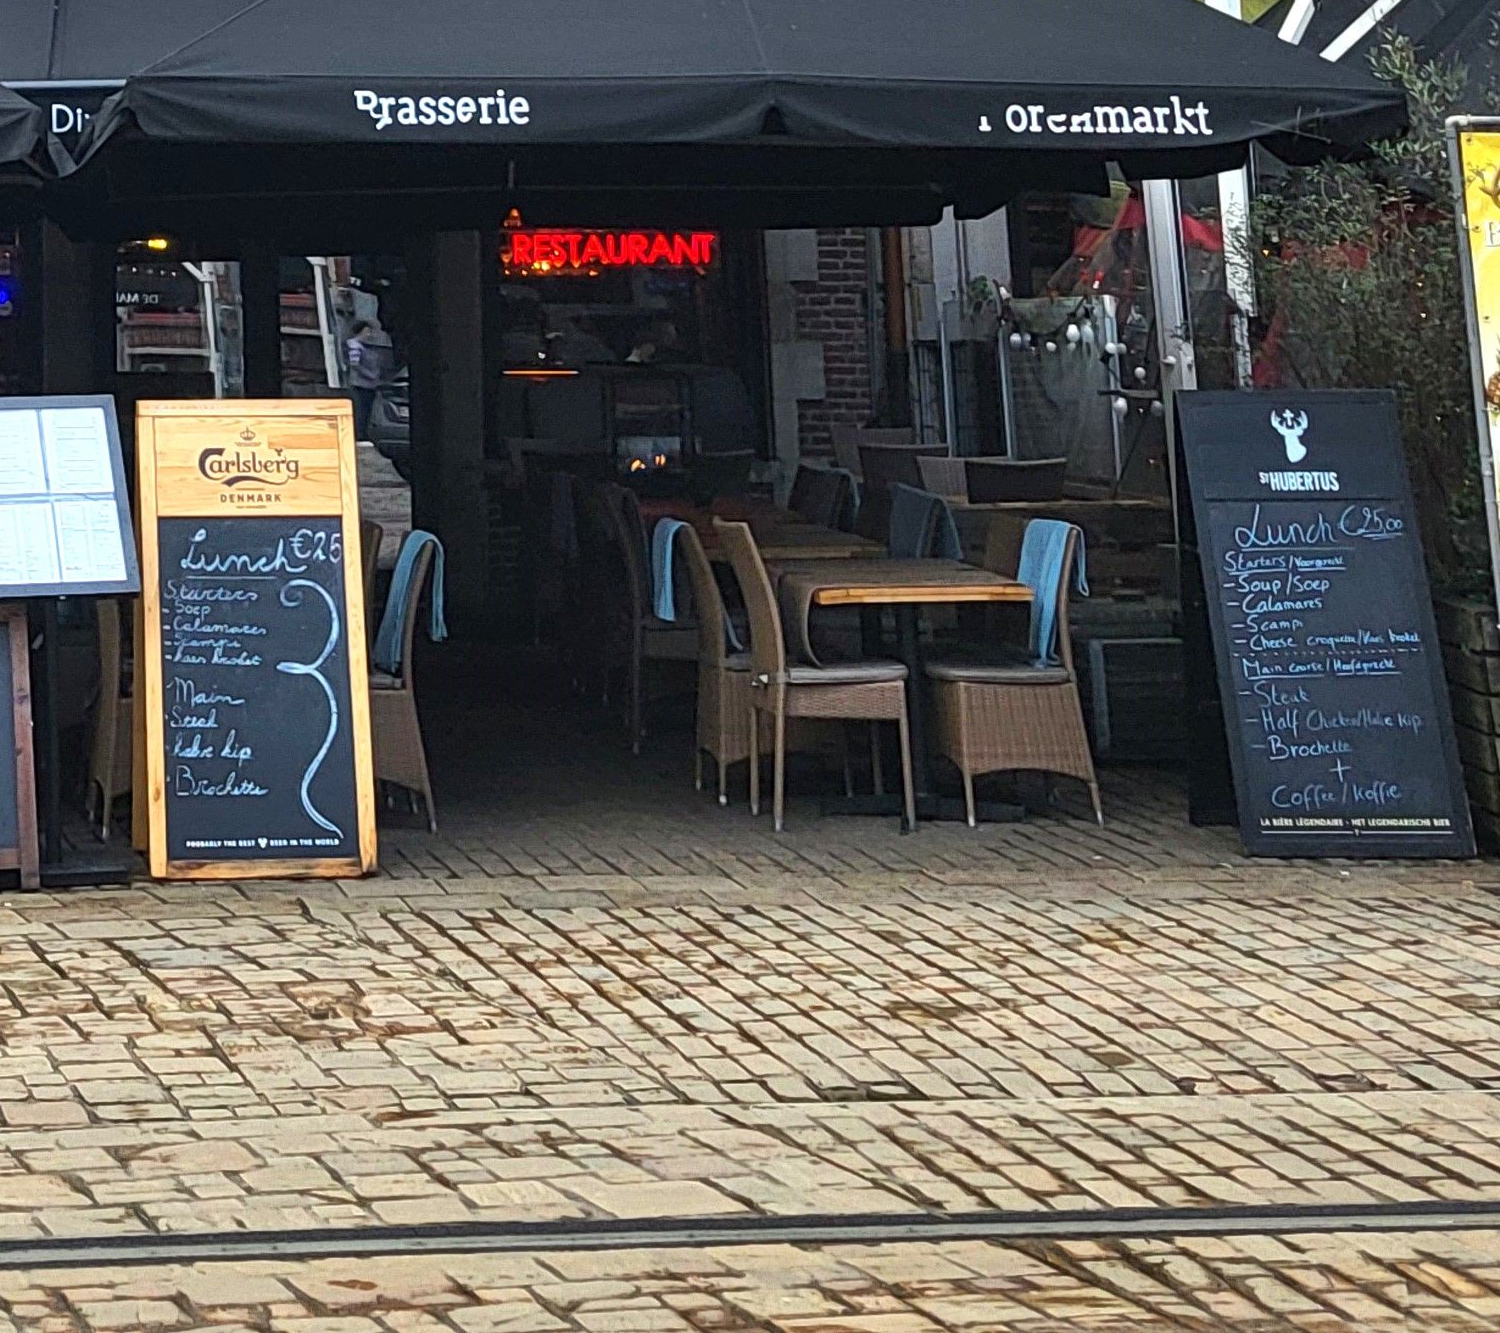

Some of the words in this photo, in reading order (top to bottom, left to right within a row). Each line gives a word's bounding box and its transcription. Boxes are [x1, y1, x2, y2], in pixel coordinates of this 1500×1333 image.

[51, 104, 91, 133] Di
[354, 89, 530, 131] Brasserie
[978, 96, 1214, 135] orenmarkt
[511, 233, 716, 266] RESTAURANT
[198, 447, 300, 482] Carlsberg
[1270, 471, 1340, 491] HUBERTUS
[220, 493, 282, 503] DENMARK
[1234, 504, 1338, 548] Lunch
[180, 528, 307, 573] Lunch
[1242, 594, 1324, 614] Calamares
[1250, 634, 1299, 651] Cheese
[1243, 658, 1283, 678] Main
[173, 676, 246, 707] Main
